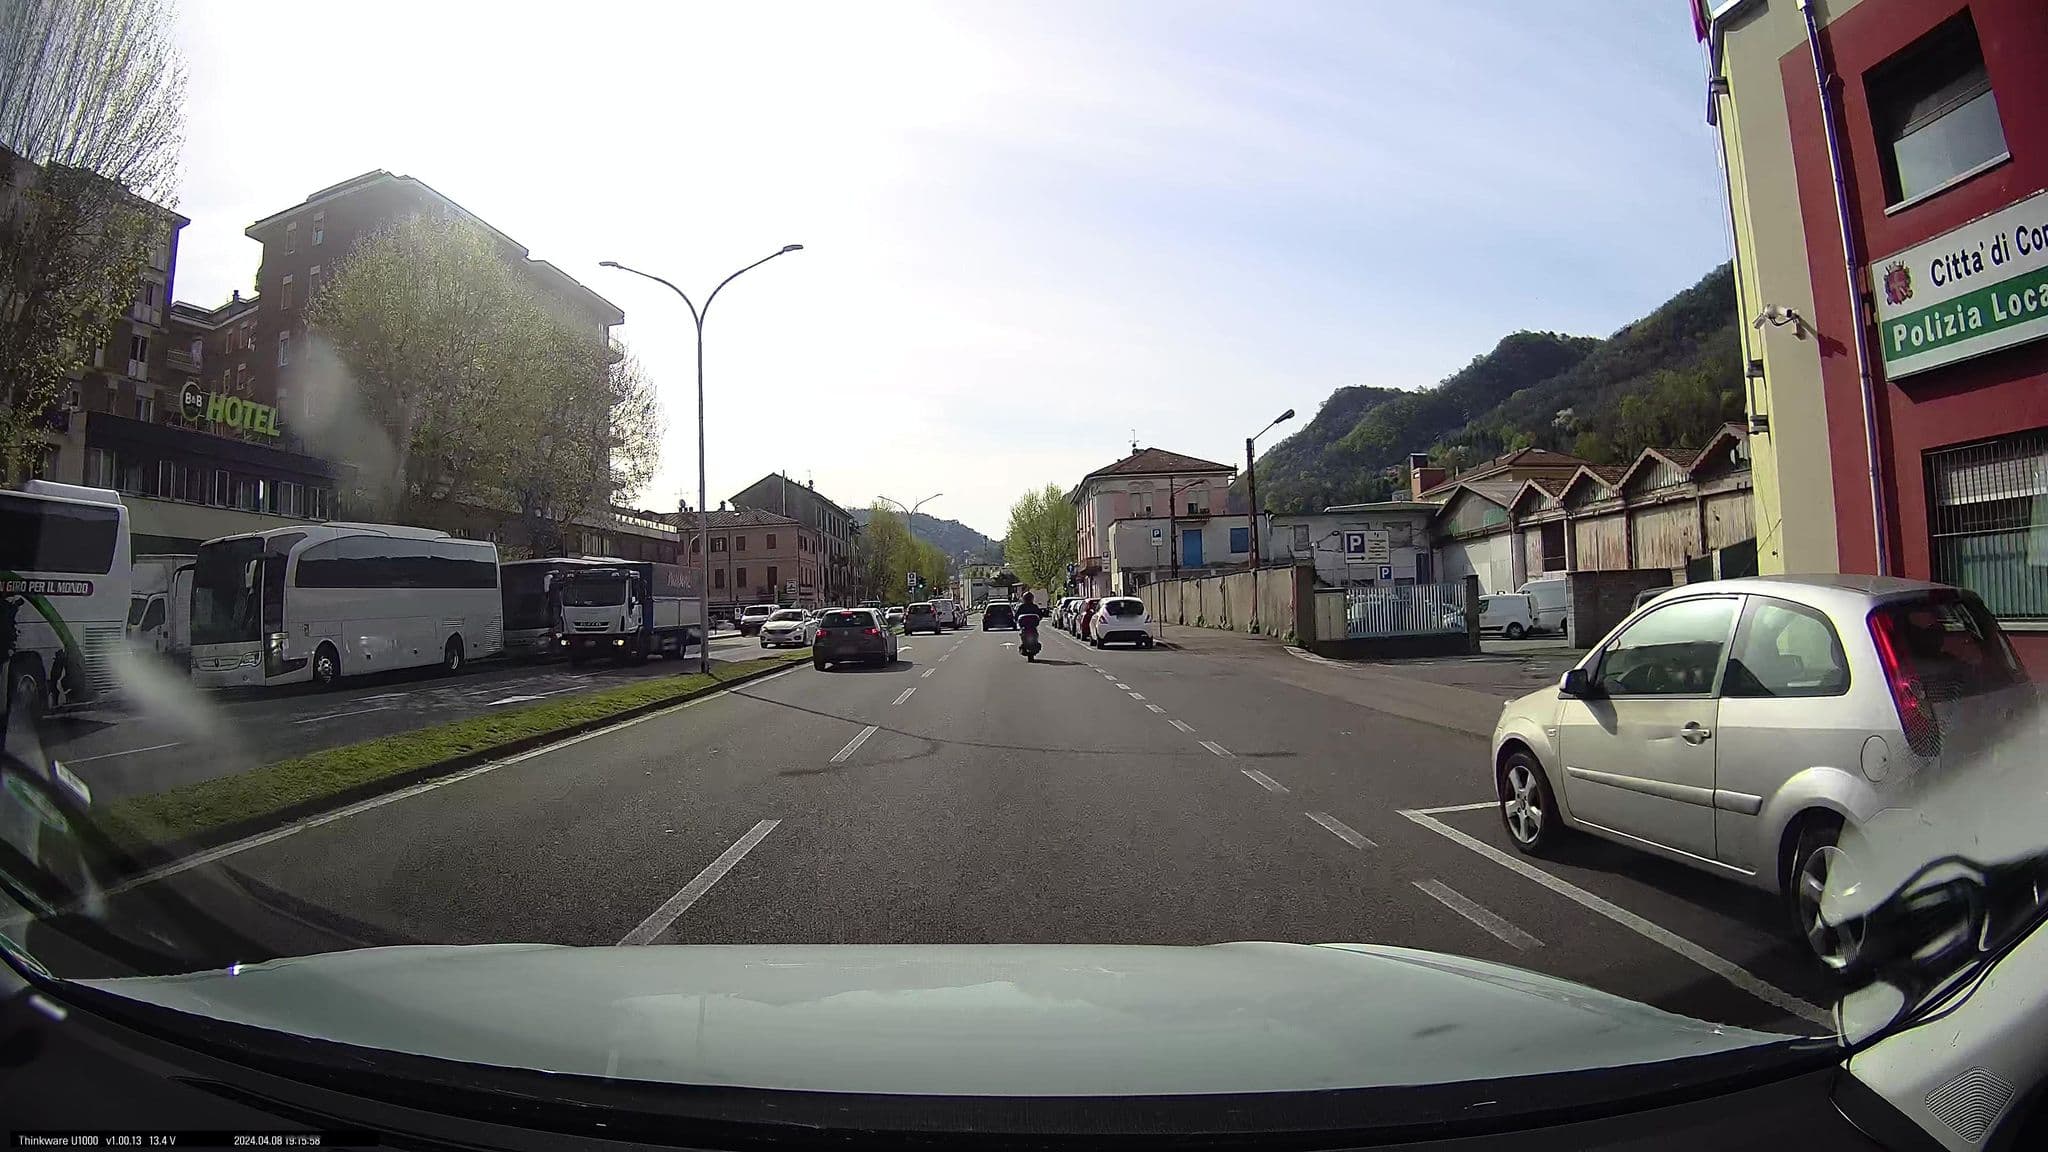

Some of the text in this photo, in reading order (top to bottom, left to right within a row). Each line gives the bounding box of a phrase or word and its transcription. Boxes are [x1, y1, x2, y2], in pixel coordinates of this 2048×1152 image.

[1990, 232, 2011, 267] di
[1892, 304, 1983, 353] Polizia
[185, 391, 203, 407] B&B
[207, 391, 280, 437] HOTEL
[1350, 535, 1362, 552] P
[1381, 567, 1390, 579] P
[6, 581, 26, 592] GIRO
[28, 581, 45, 593] PER
[47, 581, 55, 593] IL
[57, 582, 88, 594] MONDO
